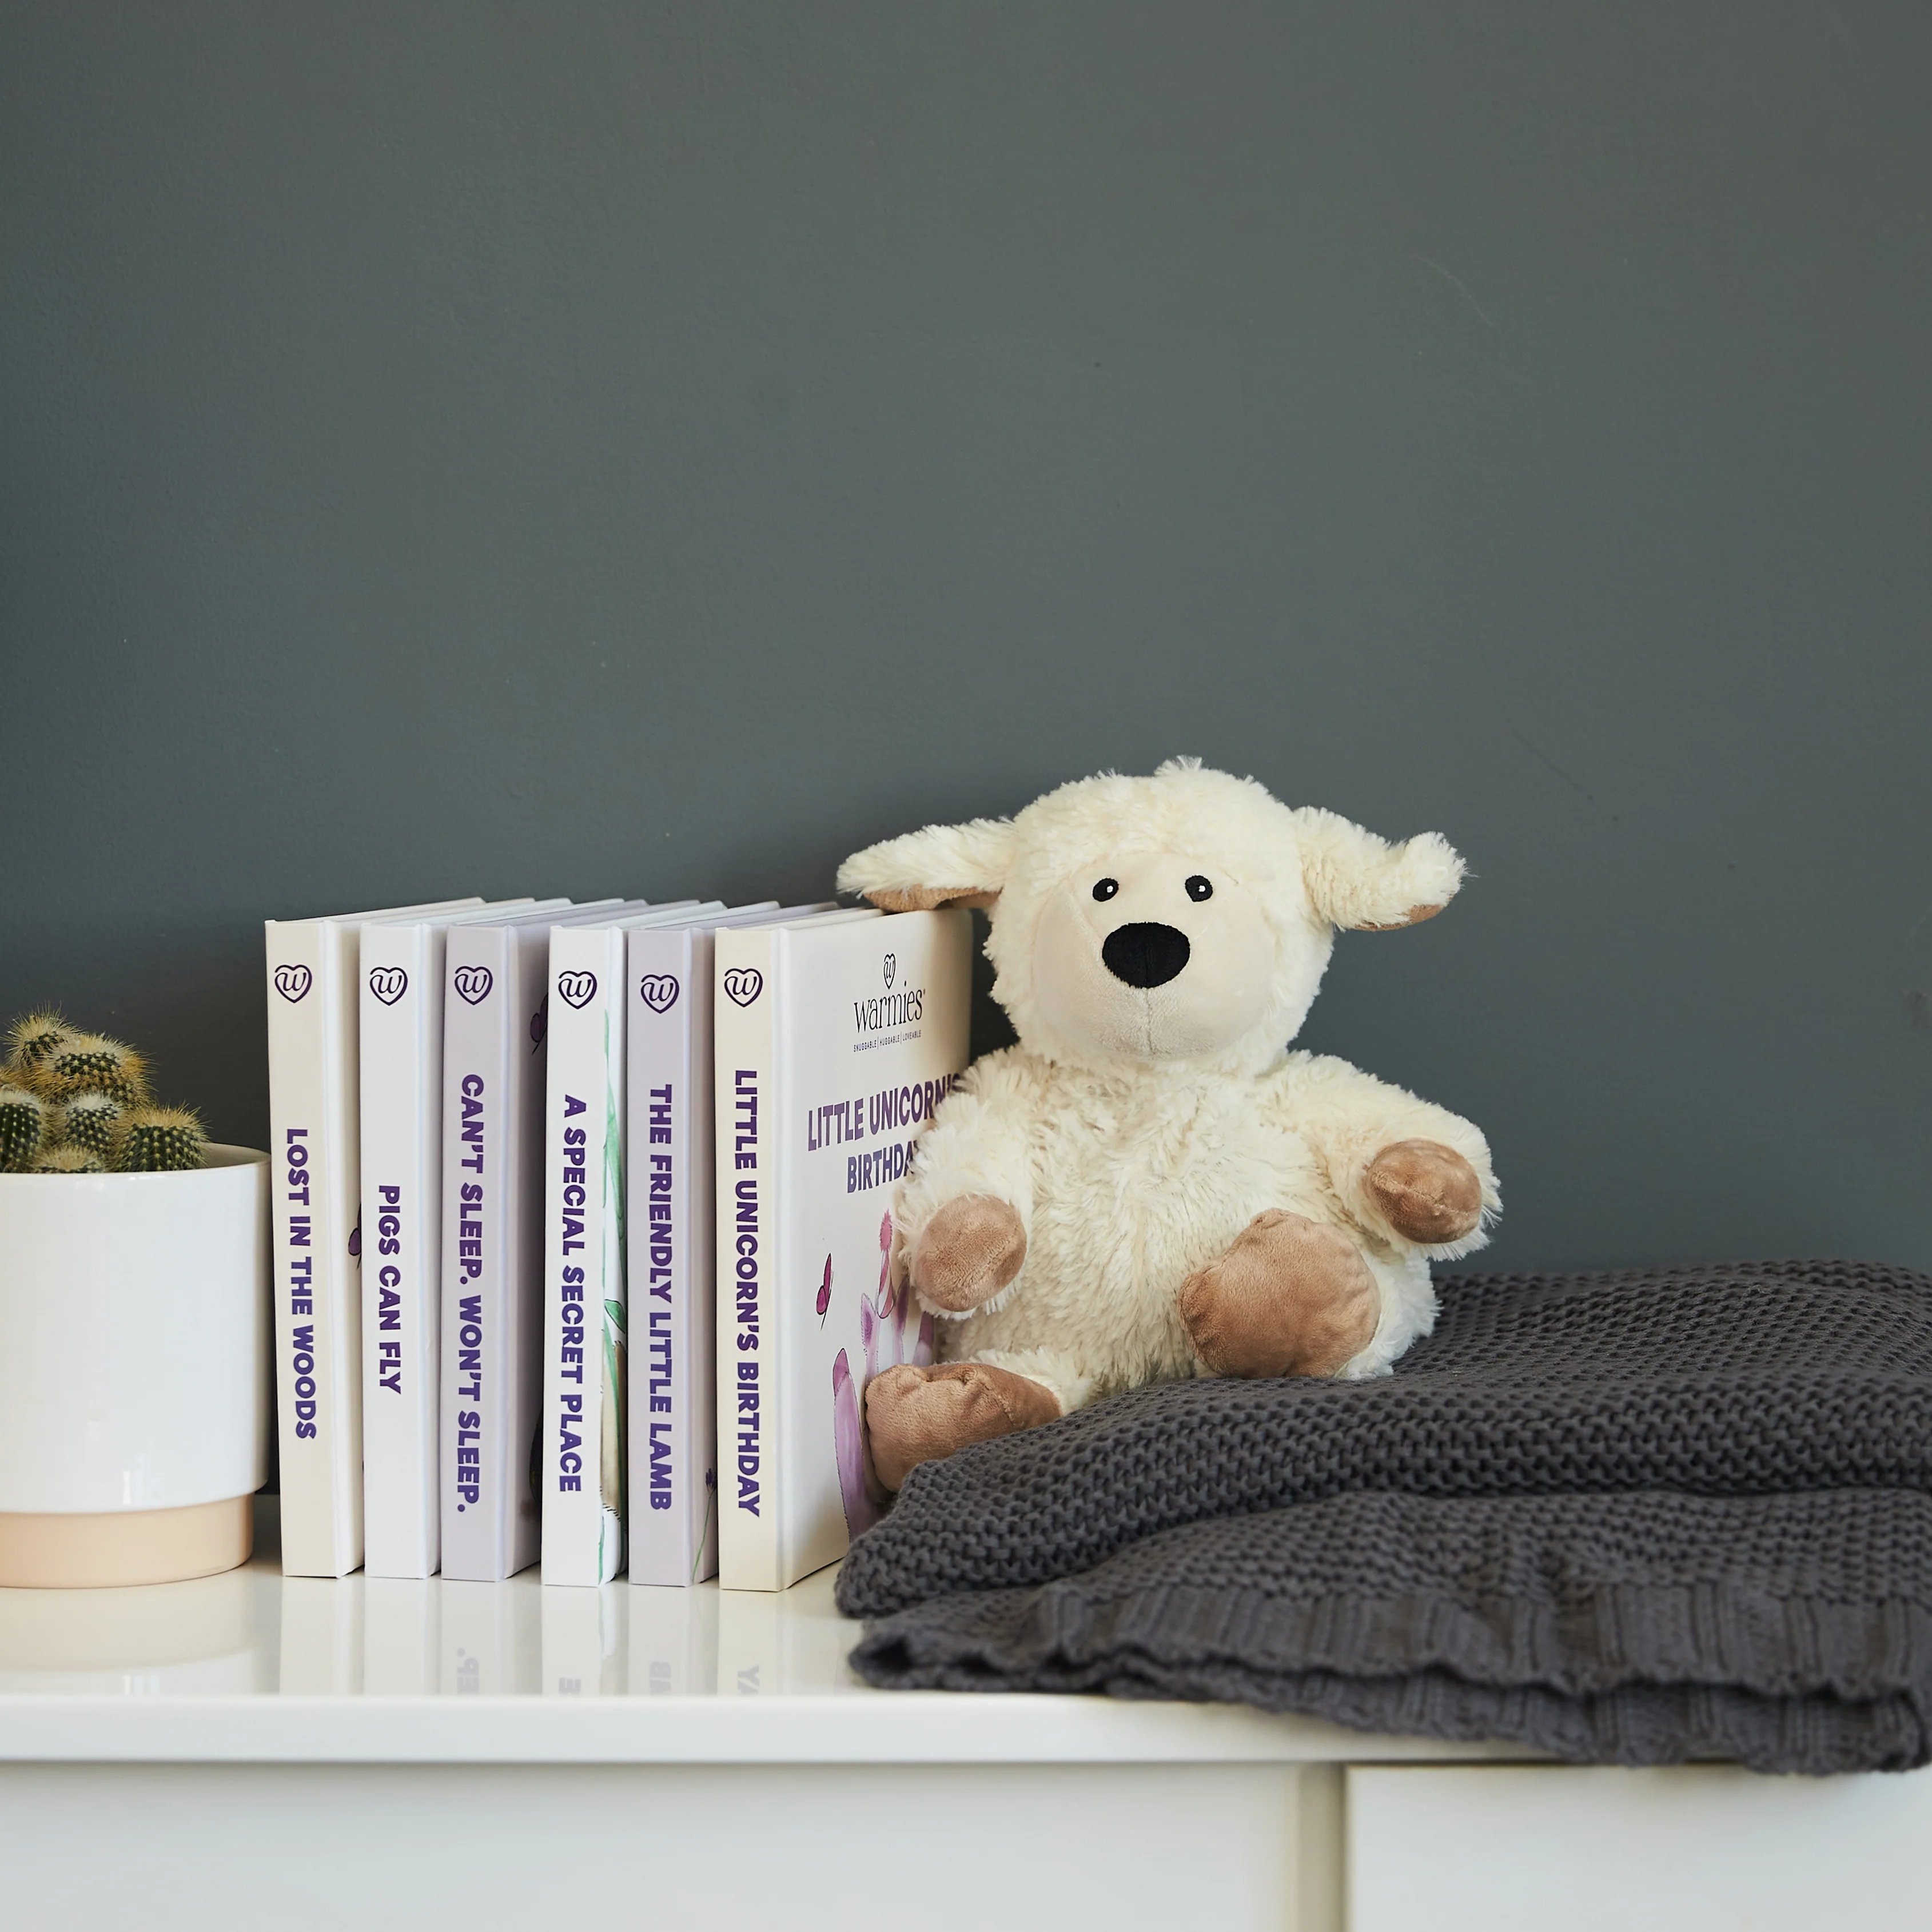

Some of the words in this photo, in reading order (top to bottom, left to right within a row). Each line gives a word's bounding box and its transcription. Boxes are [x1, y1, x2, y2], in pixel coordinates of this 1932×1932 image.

[854, 980, 923, 1033] warmies
[460, 1074, 485, 1174] CAN'T
[564, 1095, 587, 1117] A
[649, 1083, 673, 1144] THE
[735, 1070, 758, 1169] LITTLE
[808, 1098, 864, 1152] LITTLE
[286, 1129, 310, 1206] LOST
[561, 1127, 587, 1256] SPECIAL
[847, 1140, 919, 1194] BIRTHDA
[289, 1216, 312, 1245] IN
[378, 1185, 401, 1254] PIGS
[459, 1182, 484, 1284] SLEEP.
[648, 1154, 673, 1302] FRIENDLY
[735, 1180, 759, 1350] UNICORN'S
[290, 1256, 313, 1314] THE
[379, 1265, 401, 1330] CAN
[560, 1265, 585, 1384] SECRET
[292, 1325, 317, 1439] WOODS
[379, 1342, 401, 1393] FLY
[457, 1295, 483, 1401] WON'T
[649, 1312, 673, 1413] LITTLE
[456, 1411, 481, 1512] SLEEP.
[559, 1394, 583, 1492] PLACE
[648, 1423, 673, 1509] LAMB
[736, 1362, 760, 1516] BIRTHDAY
